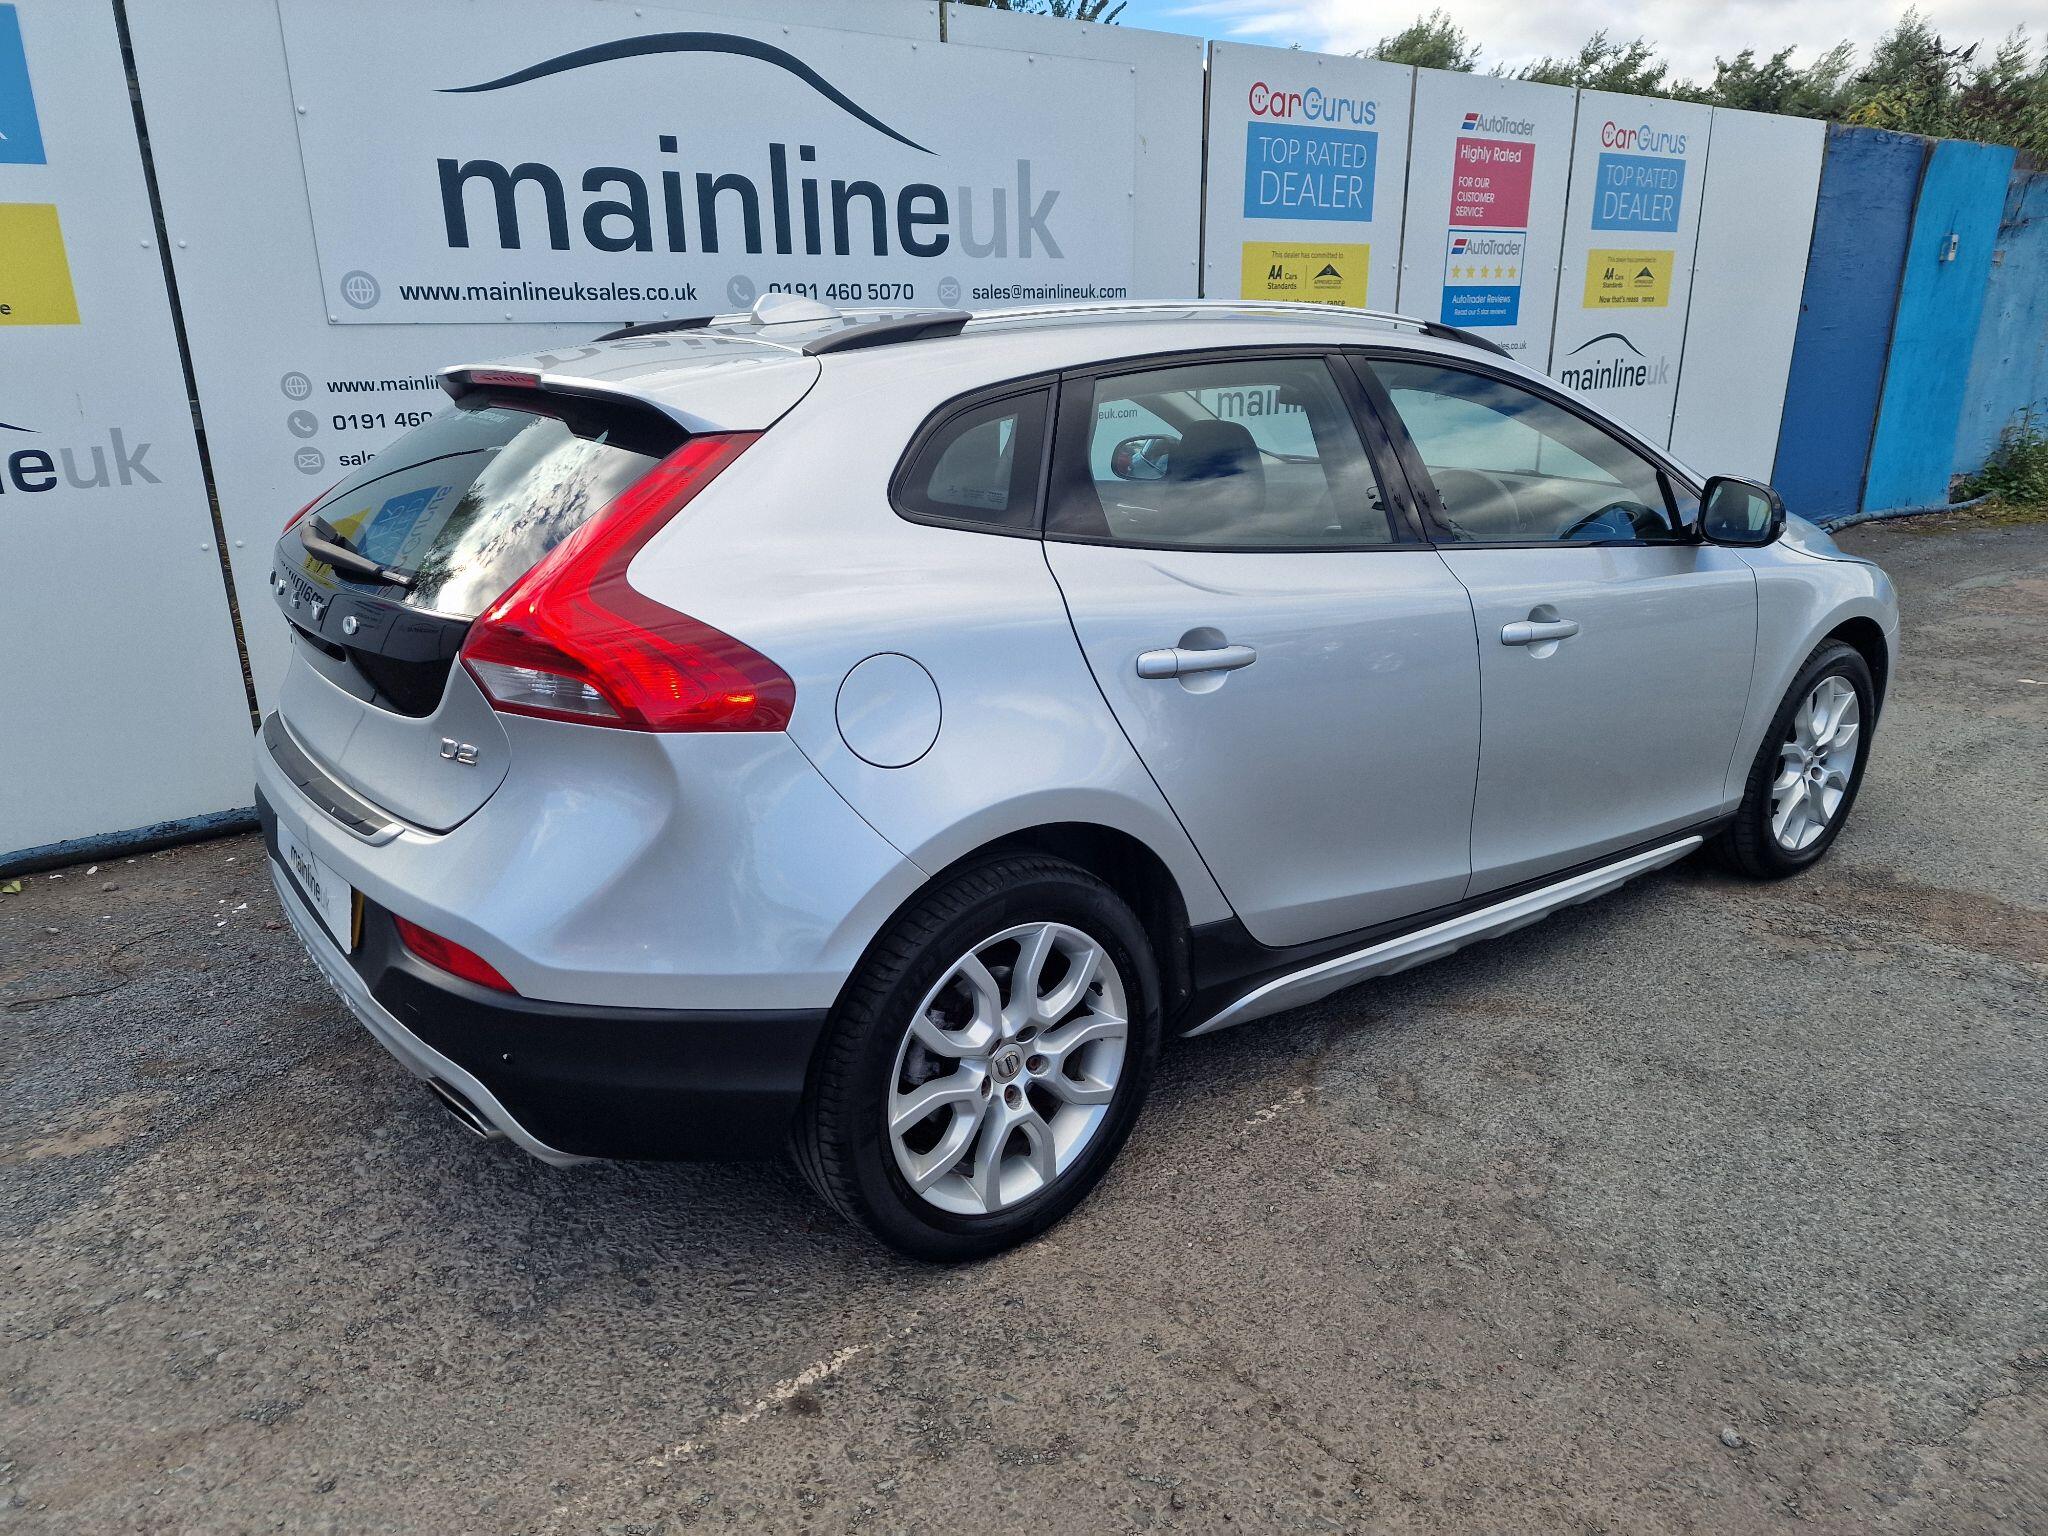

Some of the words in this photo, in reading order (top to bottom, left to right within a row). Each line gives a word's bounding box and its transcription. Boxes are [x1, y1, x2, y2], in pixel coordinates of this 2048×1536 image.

[1248, 81, 1377, 126] CarGurus
[1475, 113, 1536, 136] AutoTrader
[1601, 120, 1687, 155] CarGurus
[1258, 136, 1301, 164] TOP
[1305, 140, 1368, 169] RATED
[1460, 144, 1492, 163] Highly
[1493, 147, 1522, 163] Rated
[1458, 176, 1474, 188] FOR
[1474, 177, 1490, 188] OUR
[1605, 164, 1634, 186] TOP
[1635, 167, 1678, 190] RATED
[436, 134, 1065, 259] mainlineuk
[1259, 170, 1364, 209] DEALER
[1456, 191, 1495, 203] CUSTOMER
[1455, 206, 1484, 218] SERVICE
[1602, 191, 1674, 222] DEALER
[1465, 238, 1521, 256] AutoTrader
[1267, 264, 1283, 280] AA
[1603, 267, 1615, 280] AA
[399, 281, 698, 301] www.mainlineuksales.co.uk
[825, 283, 861, 300] 460
[867, 283, 914, 300] 5070
[972, 283, 1127, 300] sales@mainlineuk.com
[1267, 281, 1297, 290] Standards
[1452, 294, 1486, 304] AutoTrader
[1560, 356, 1670, 391] mainlineuk
[332, 412, 386, 430] 0191
[0, 427, 164, 494] euk
[440, 737, 479, 767] D2
